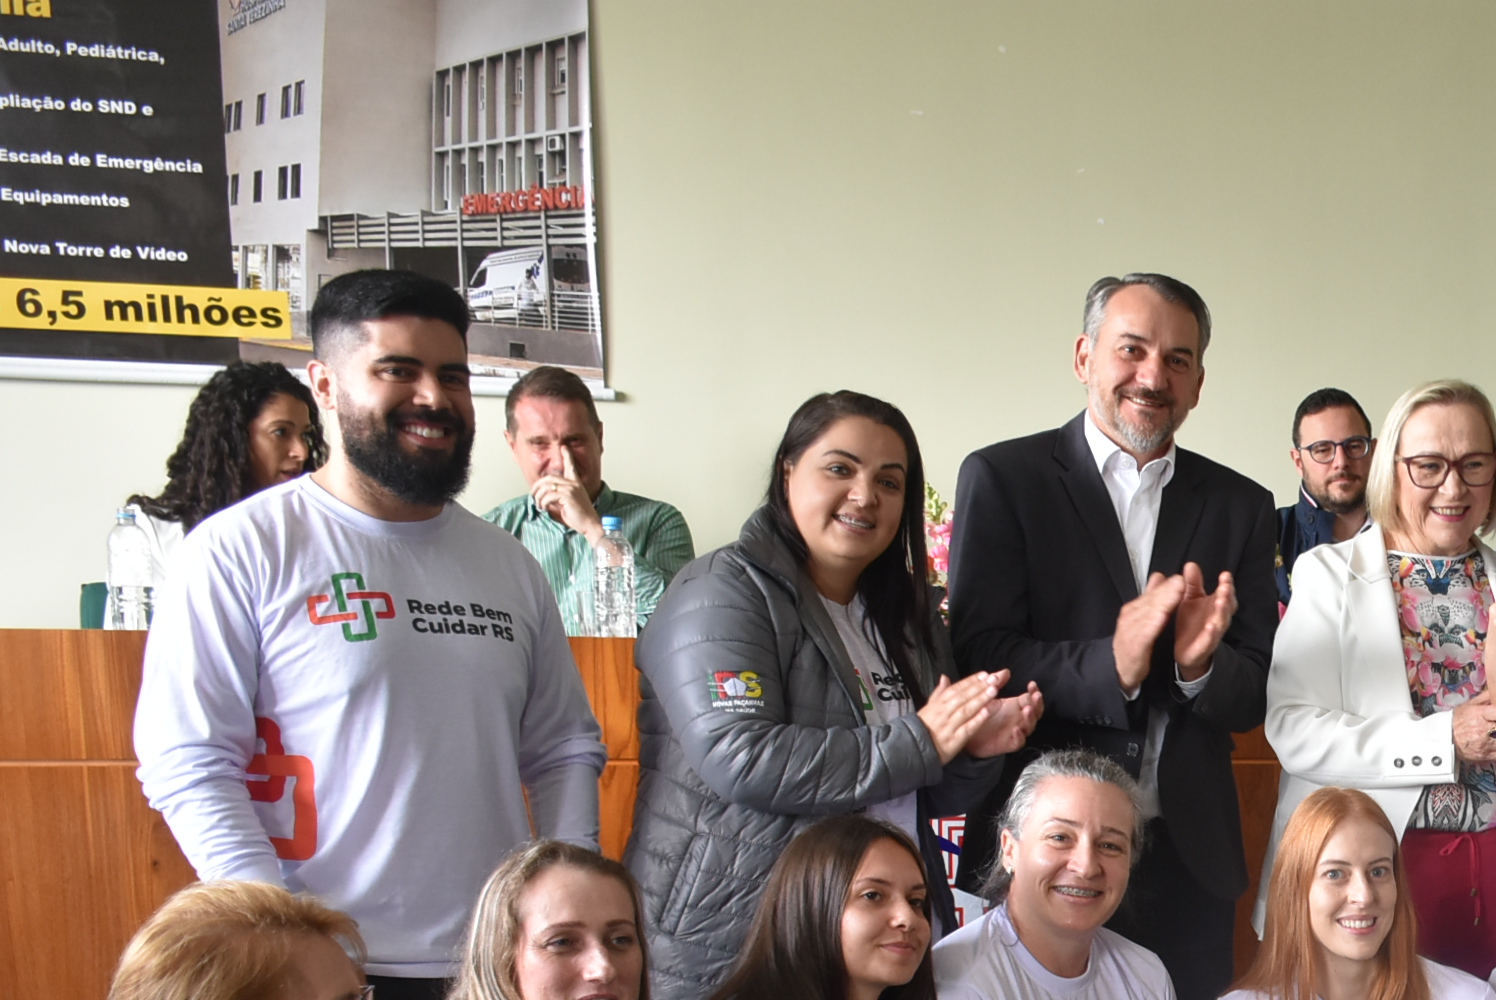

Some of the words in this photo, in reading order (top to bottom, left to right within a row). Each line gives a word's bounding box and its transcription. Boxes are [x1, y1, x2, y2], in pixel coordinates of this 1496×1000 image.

[65, 42, 165, 65] Pediátrica,
[70, 98, 93, 112] do
[98, 99, 137, 115] SND
[141, 105, 154, 116] e
[0, 149, 63, 166] Escada
[68, 153, 91, 167] de
[96, 154, 203, 174] Emergência
[0, 187, 130, 208] Equipamentos
[4, 239, 50, 255] Nova
[55, 242, 104, 258] Torre
[109, 244, 132, 259] de
[136, 246, 189, 262] Vídeo
[16, 287, 87, 326] 6,5
[104, 293, 284, 329] milhões
[406, 598, 467, 616] Rede
[469, 603, 513, 625] Bem
[412, 617, 488, 636] Cuidar
[491, 623, 515, 642] RS
